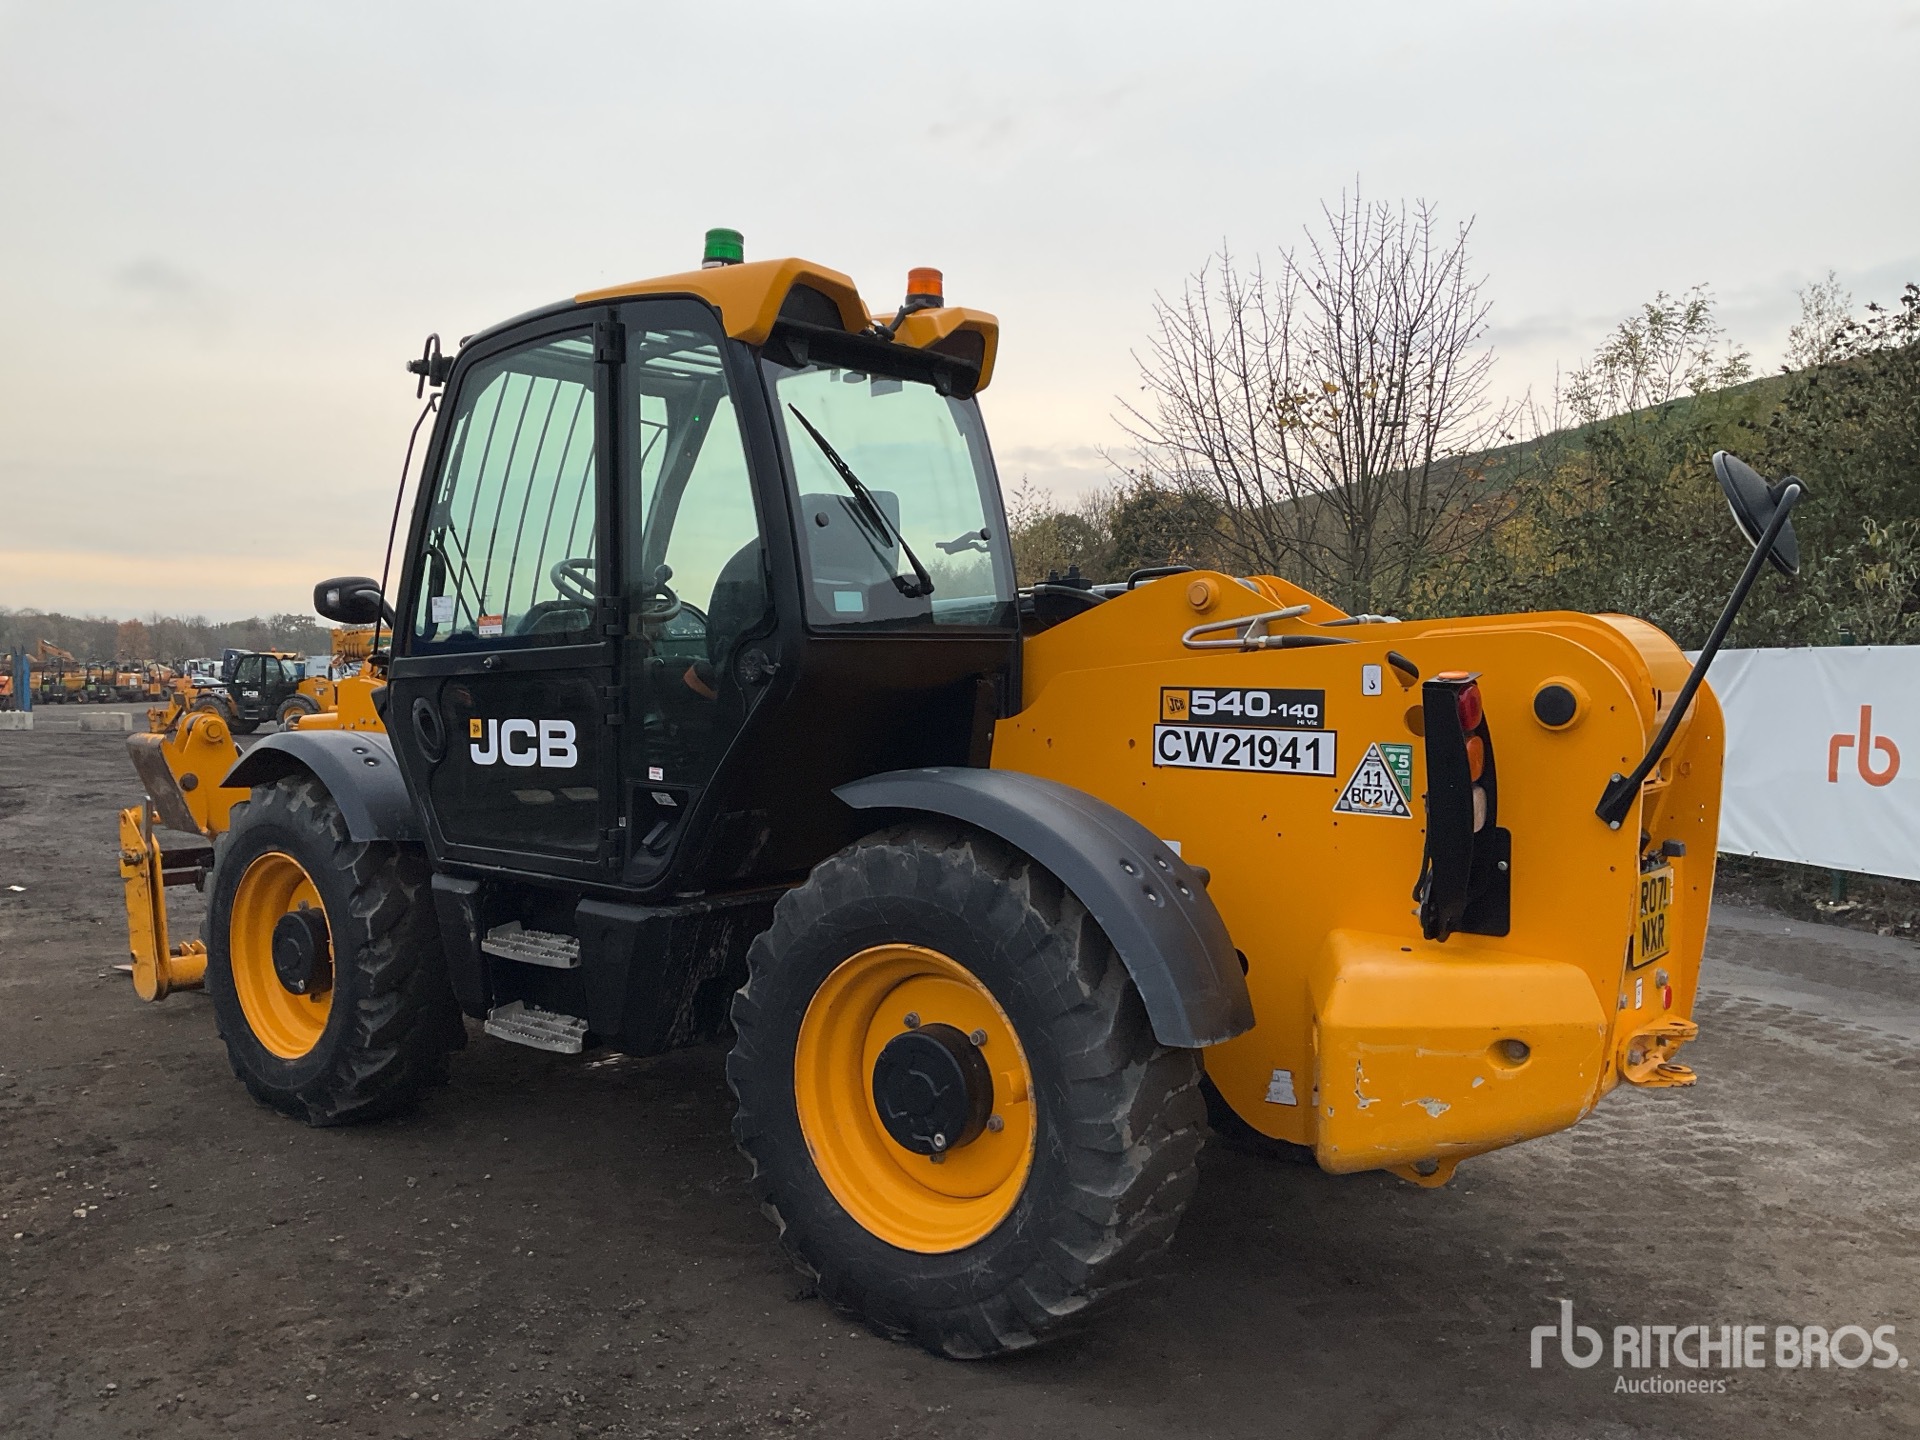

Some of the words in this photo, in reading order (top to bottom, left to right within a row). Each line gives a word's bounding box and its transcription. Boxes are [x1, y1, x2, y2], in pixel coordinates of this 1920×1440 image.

[1168, 696, 1186, 713] JCB
[1190, 690, 1319, 719] 540-140
[469, 719, 578, 768] JCB
[1158, 729, 1320, 771] CW21941
[1828, 705, 1901, 787] rb
[1398, 755, 1409, 768] 5
[1363, 770, 1382, 788] 11
[1351, 788, 1394, 806] BC2V
[1641, 913, 1665, 957] NXR
